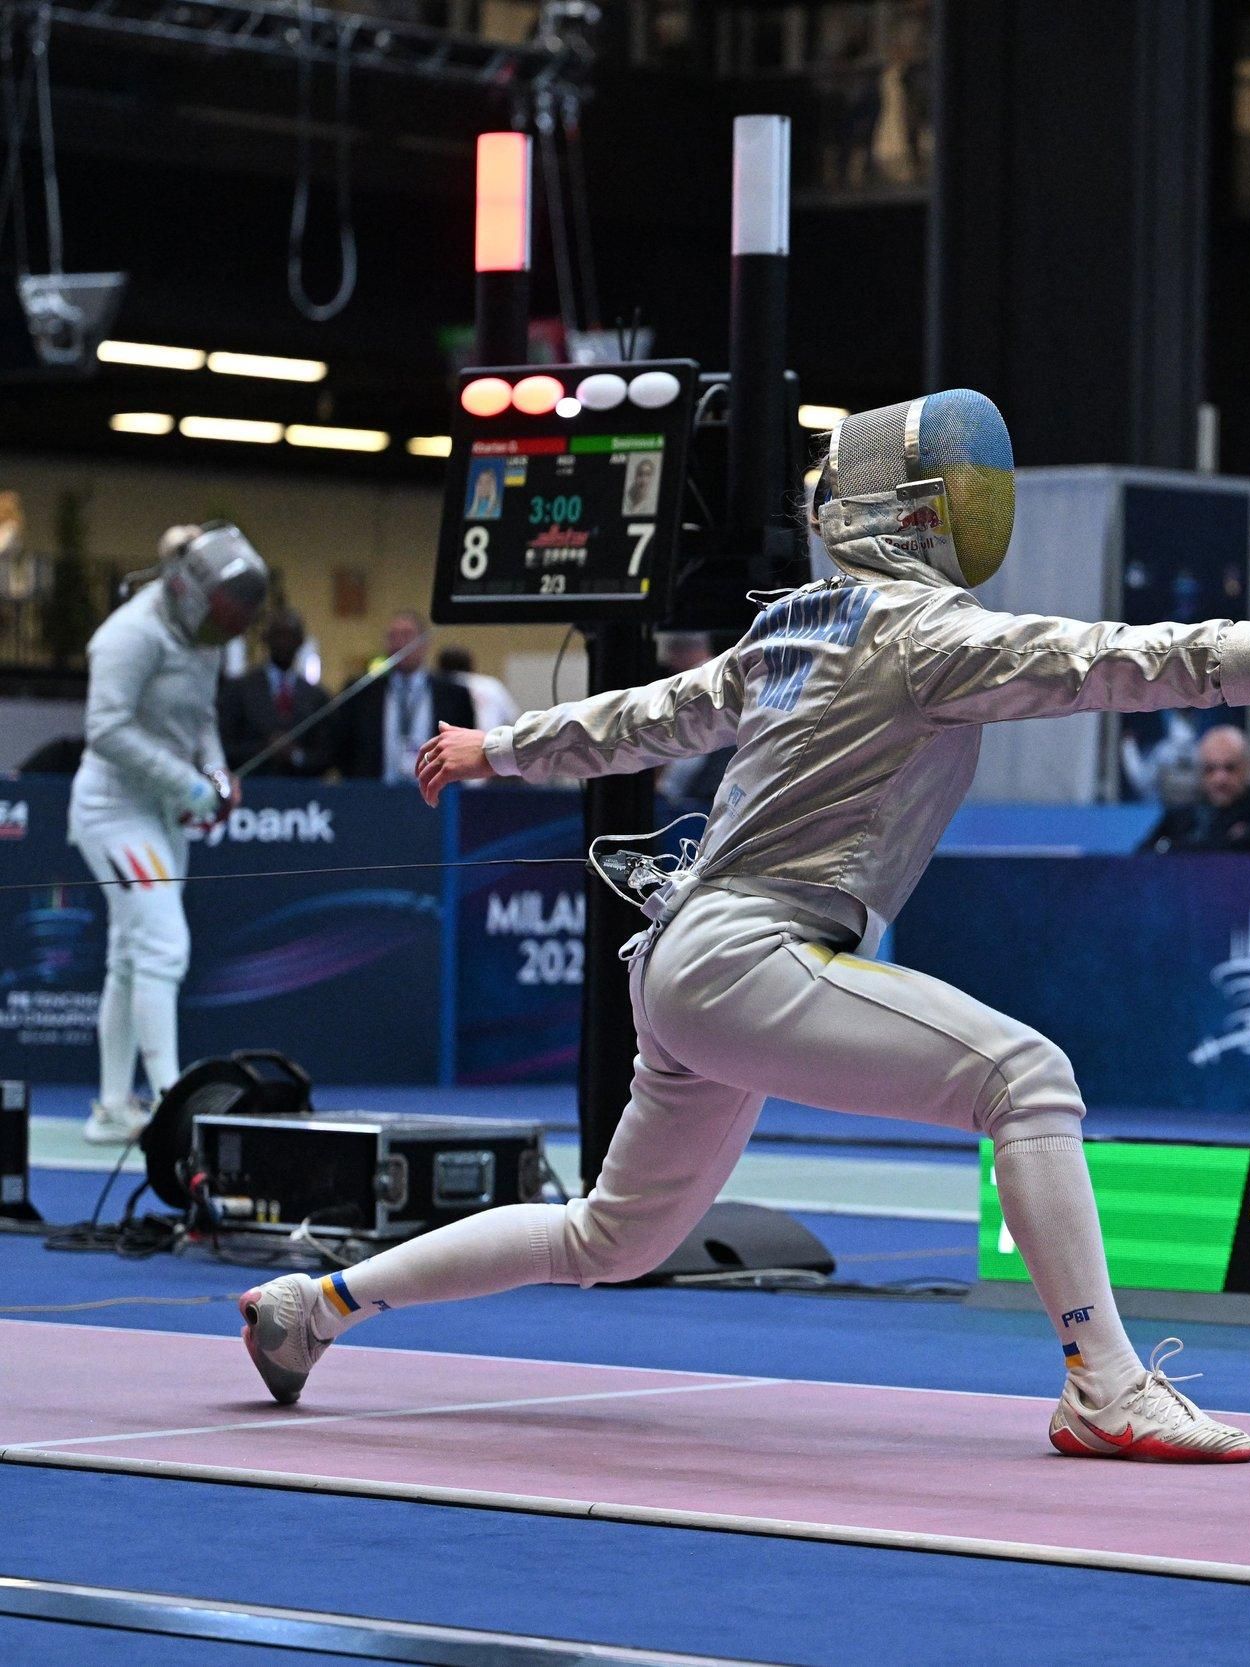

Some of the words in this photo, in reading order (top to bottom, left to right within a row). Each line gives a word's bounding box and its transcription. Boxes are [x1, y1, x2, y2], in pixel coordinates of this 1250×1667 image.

[528, 495, 583, 525] 3:00
[460, 526, 490, 580] 8
[626, 523, 656, 576] 7
[486, 890, 586, 936] MILA
[517, 939, 586, 985] 202
[1061, 1305, 1095, 1328] PBT
